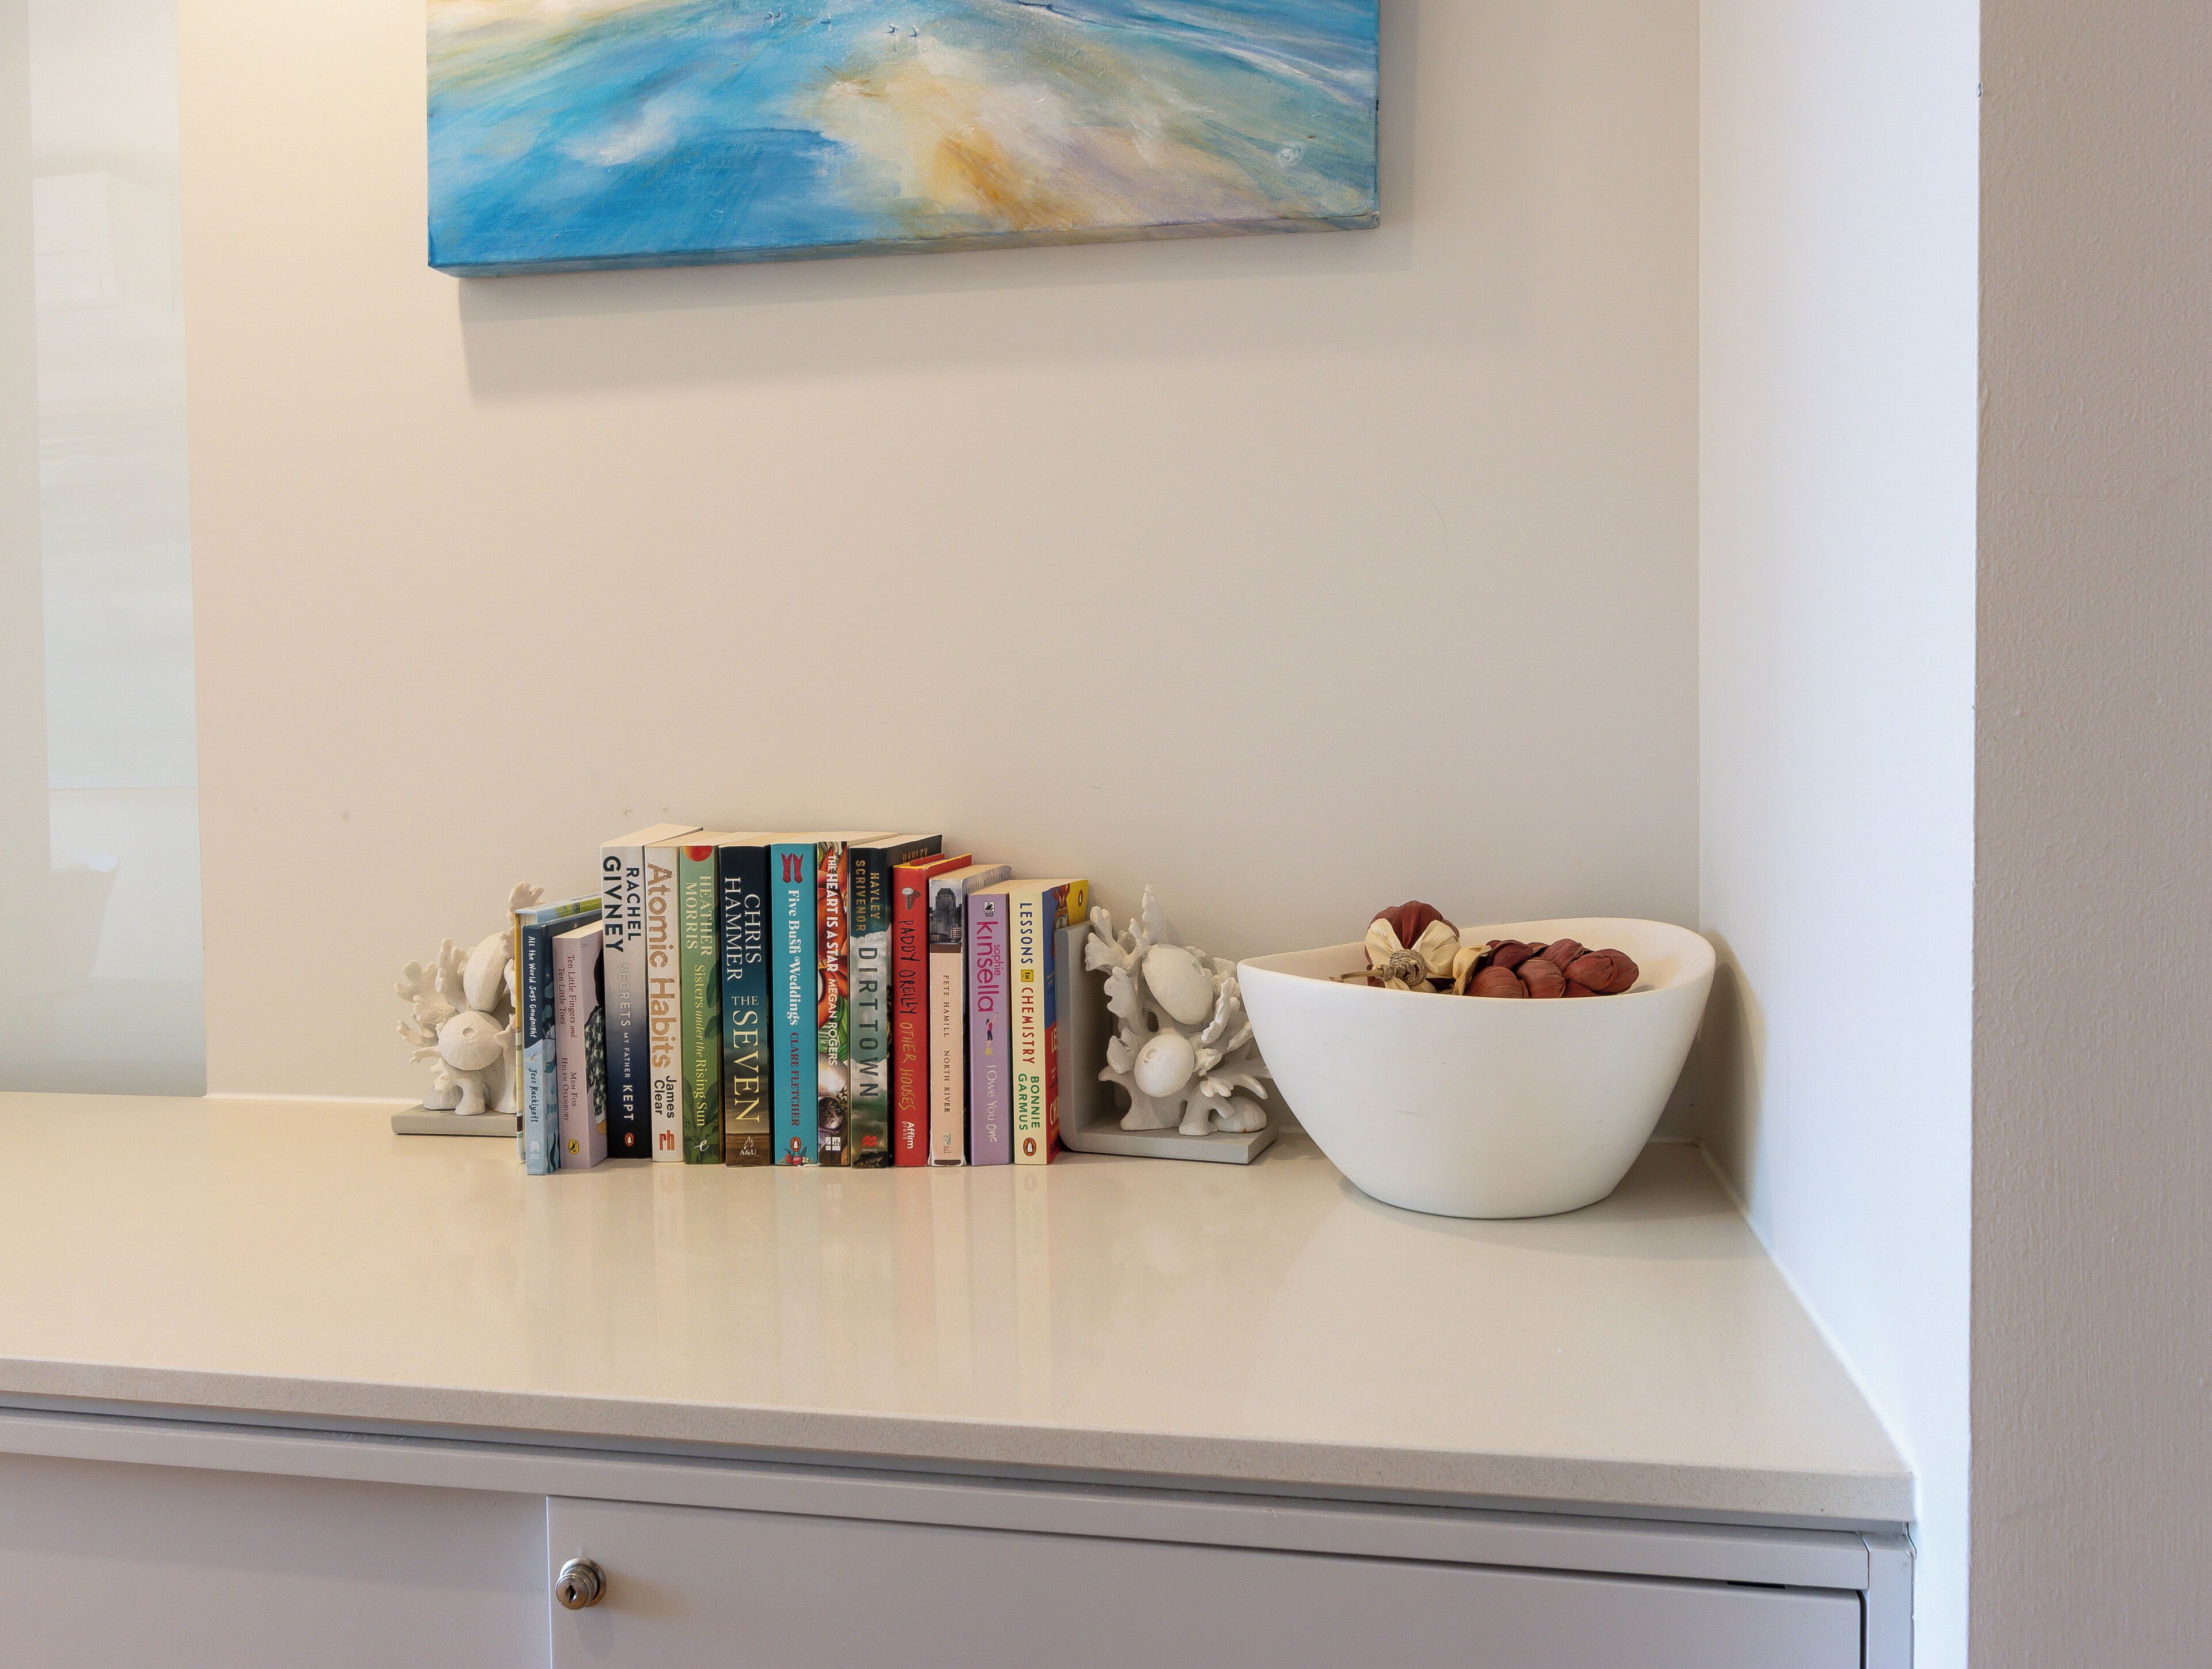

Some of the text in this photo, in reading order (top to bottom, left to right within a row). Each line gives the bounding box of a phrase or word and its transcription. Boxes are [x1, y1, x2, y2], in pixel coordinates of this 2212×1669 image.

[603, 856, 623, 952] GIVNEY
[627, 868, 641, 941] RACHEL
[685, 882, 699, 949] MORRIS
[700, 876, 712, 955] HEATHER
[725, 877, 743, 981] HAMMER
[744, 894, 761, 963] CHRIS
[827, 856, 838, 971] THE HEART IS A STAR
[856, 860, 866, 931] SCRIVENOR
[870, 873, 880, 919] HAYLEY
[528, 963, 536, 982] World
[647, 863, 676, 1068] Atomic Habits
[787, 890, 802, 1025] Five Bush Weddings
[898, 921, 920, 1014] PADDY O'REILLY
[976, 921, 998, 1012] kinsella
[993, 945, 1004, 975] sophie
[1020, 903, 1035, 1064] LESSONS In CHEMISTRY
[528, 986, 536, 1001] Says
[528, 1005, 538, 1038] Goodnight
[567, 995, 576, 1023] Fingers
[732, 996, 759, 1005] THE
[828, 978, 838, 1065] MEGAN ROGERS
[858, 947, 878, 1097] DIRT TOWN
[619, 964, 634, 1120] SECRETS MY FATHER KEPT
[694, 965, 707, 1126] Sisters under the Rising Sun
[732, 1010, 760, 1123] SEVEN
[897, 1023, 915, 1110] OTHER HOUSES
[529, 1068, 539, 1122] Jess Racklyeft
[654, 1080, 665, 1115] Clear
[666, 1076, 676, 1118] James
[791, 1032, 800, 1126] CLARE FLETCHER
[987, 1070, 997, 1096] Owe
[987, 1101, 997, 1121] You
[1018, 1074, 1028, 1130] GARMUS
[1031, 1076, 1040, 1128] BONNIE
[986, 1124, 998, 1142] One
